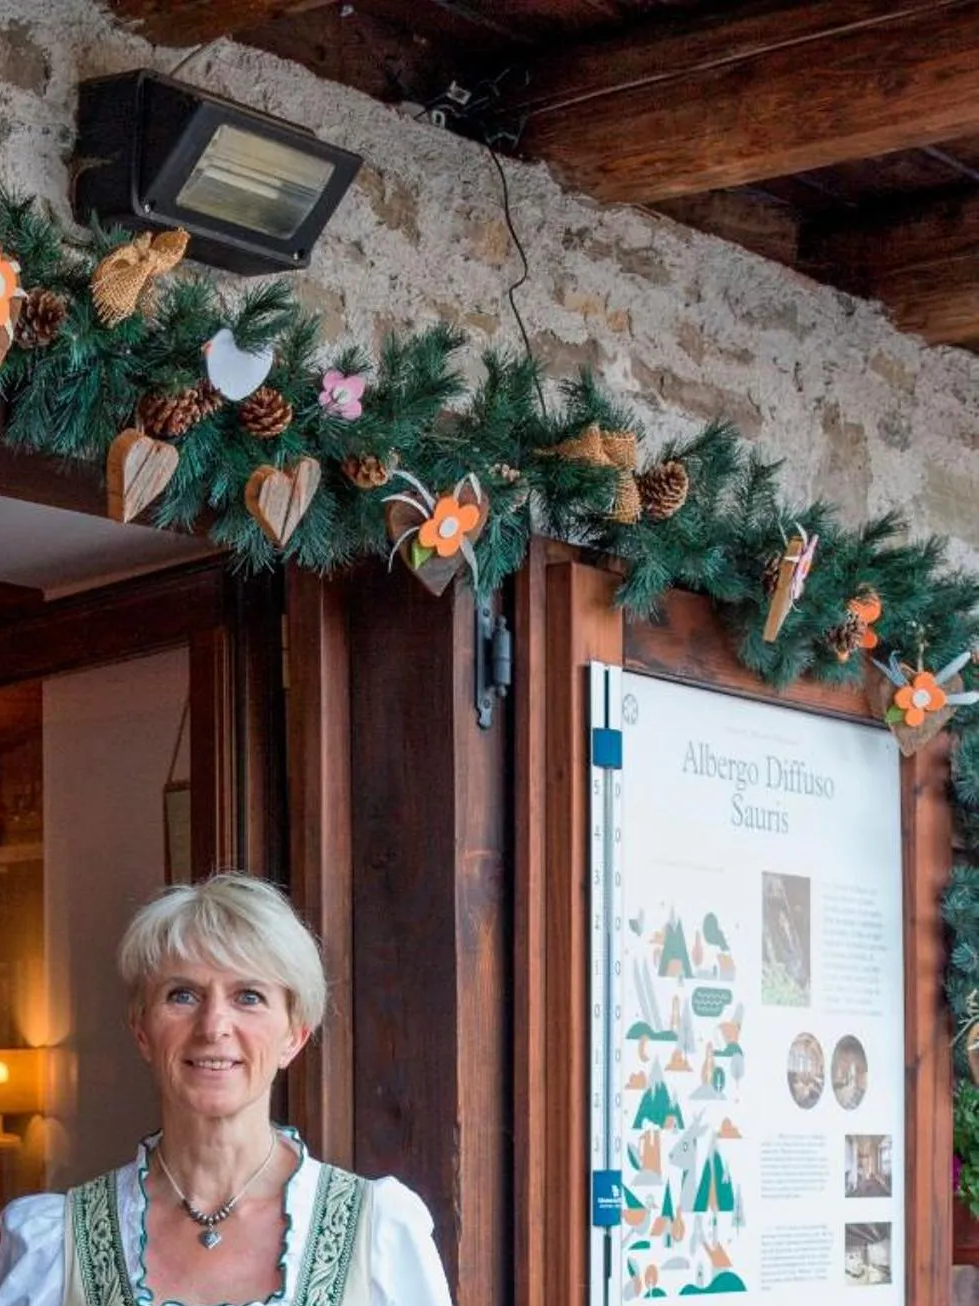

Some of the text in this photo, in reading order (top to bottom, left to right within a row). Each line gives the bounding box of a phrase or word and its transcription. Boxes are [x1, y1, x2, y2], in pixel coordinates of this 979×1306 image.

[682, 739, 836, 800] Albergo Diffuso
[730, 793, 790, 834] Sauris
